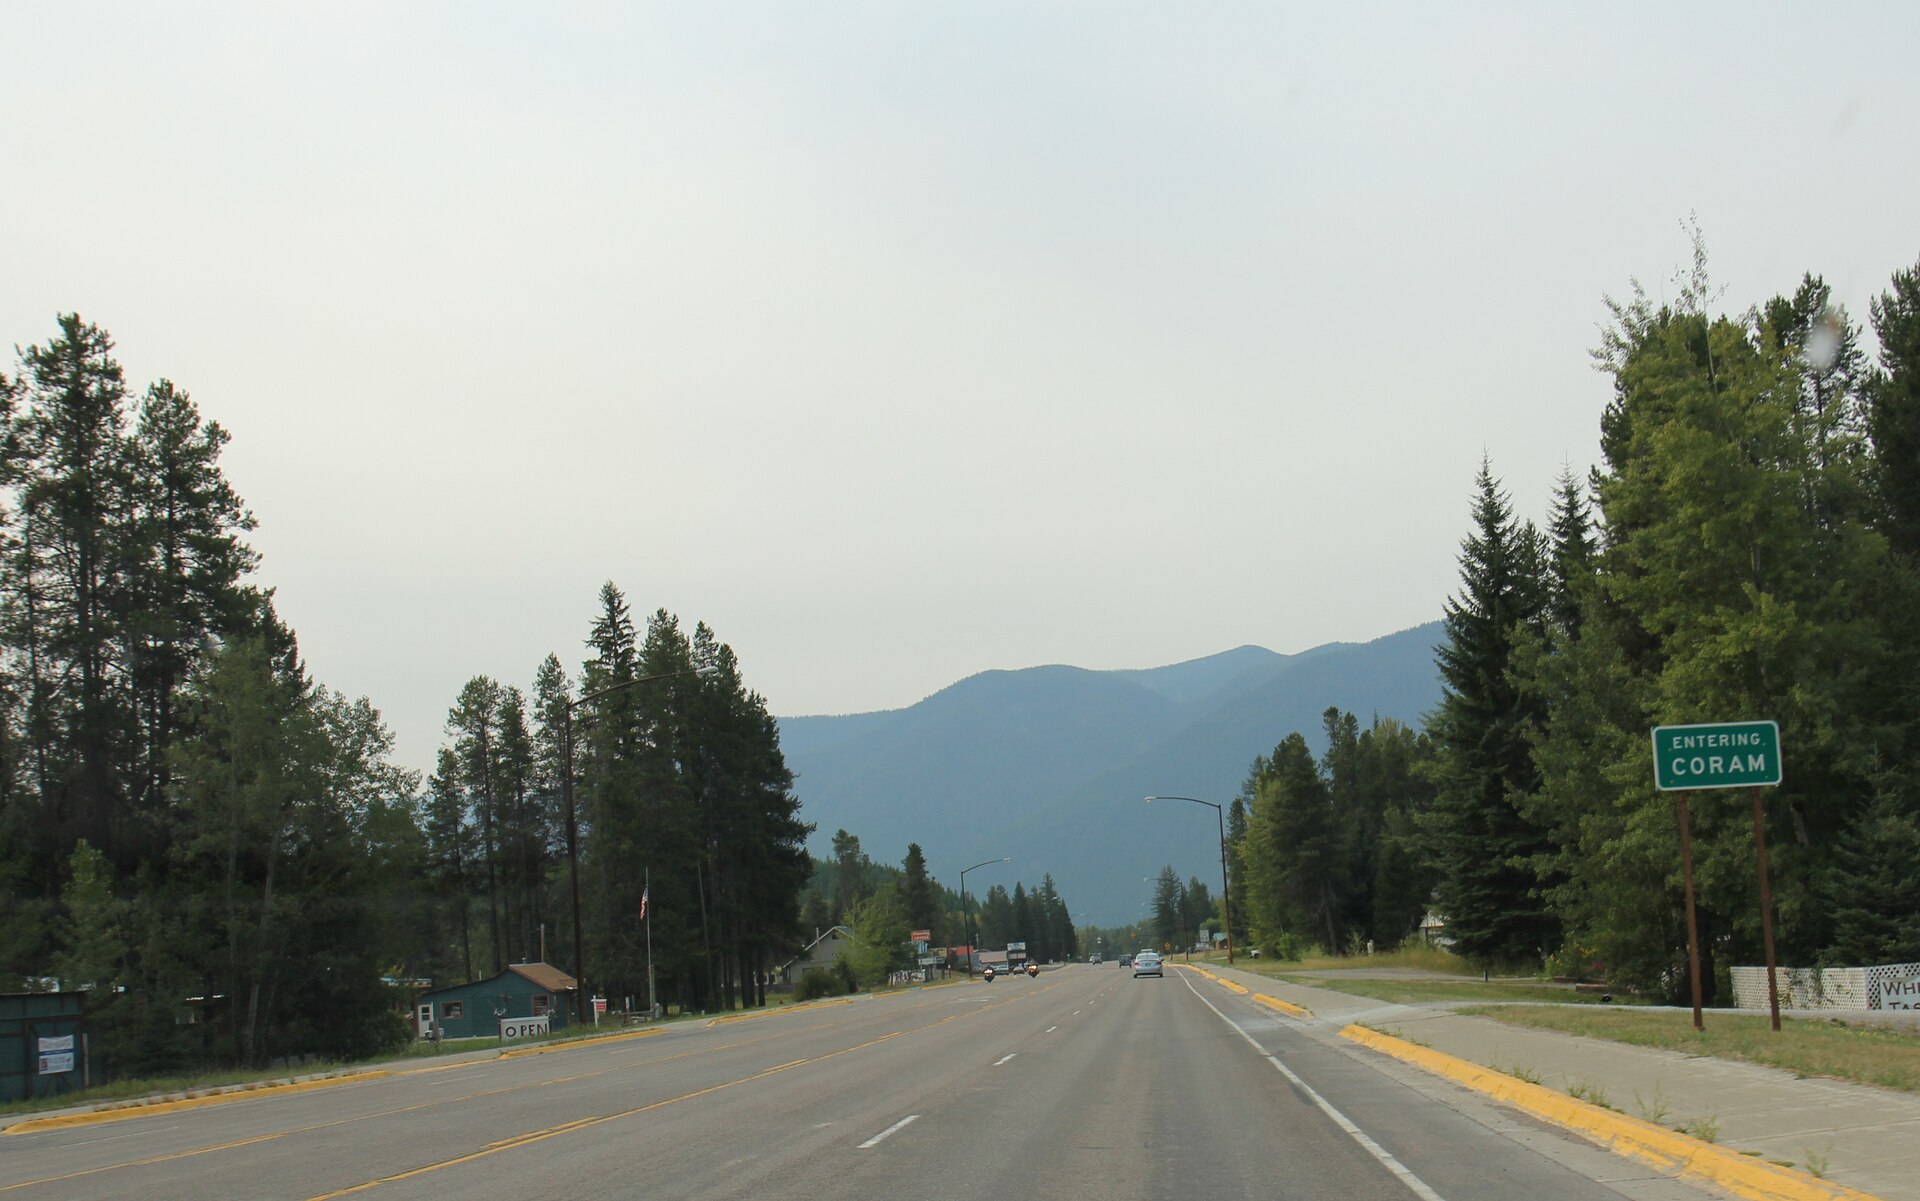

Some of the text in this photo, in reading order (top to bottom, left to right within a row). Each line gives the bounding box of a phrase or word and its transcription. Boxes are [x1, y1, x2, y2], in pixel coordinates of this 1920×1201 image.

[1672, 733, 1761, 749] ENTERING
[1672, 754, 1766, 775] CORAM
[505, 1024, 548, 1037] OPEN
